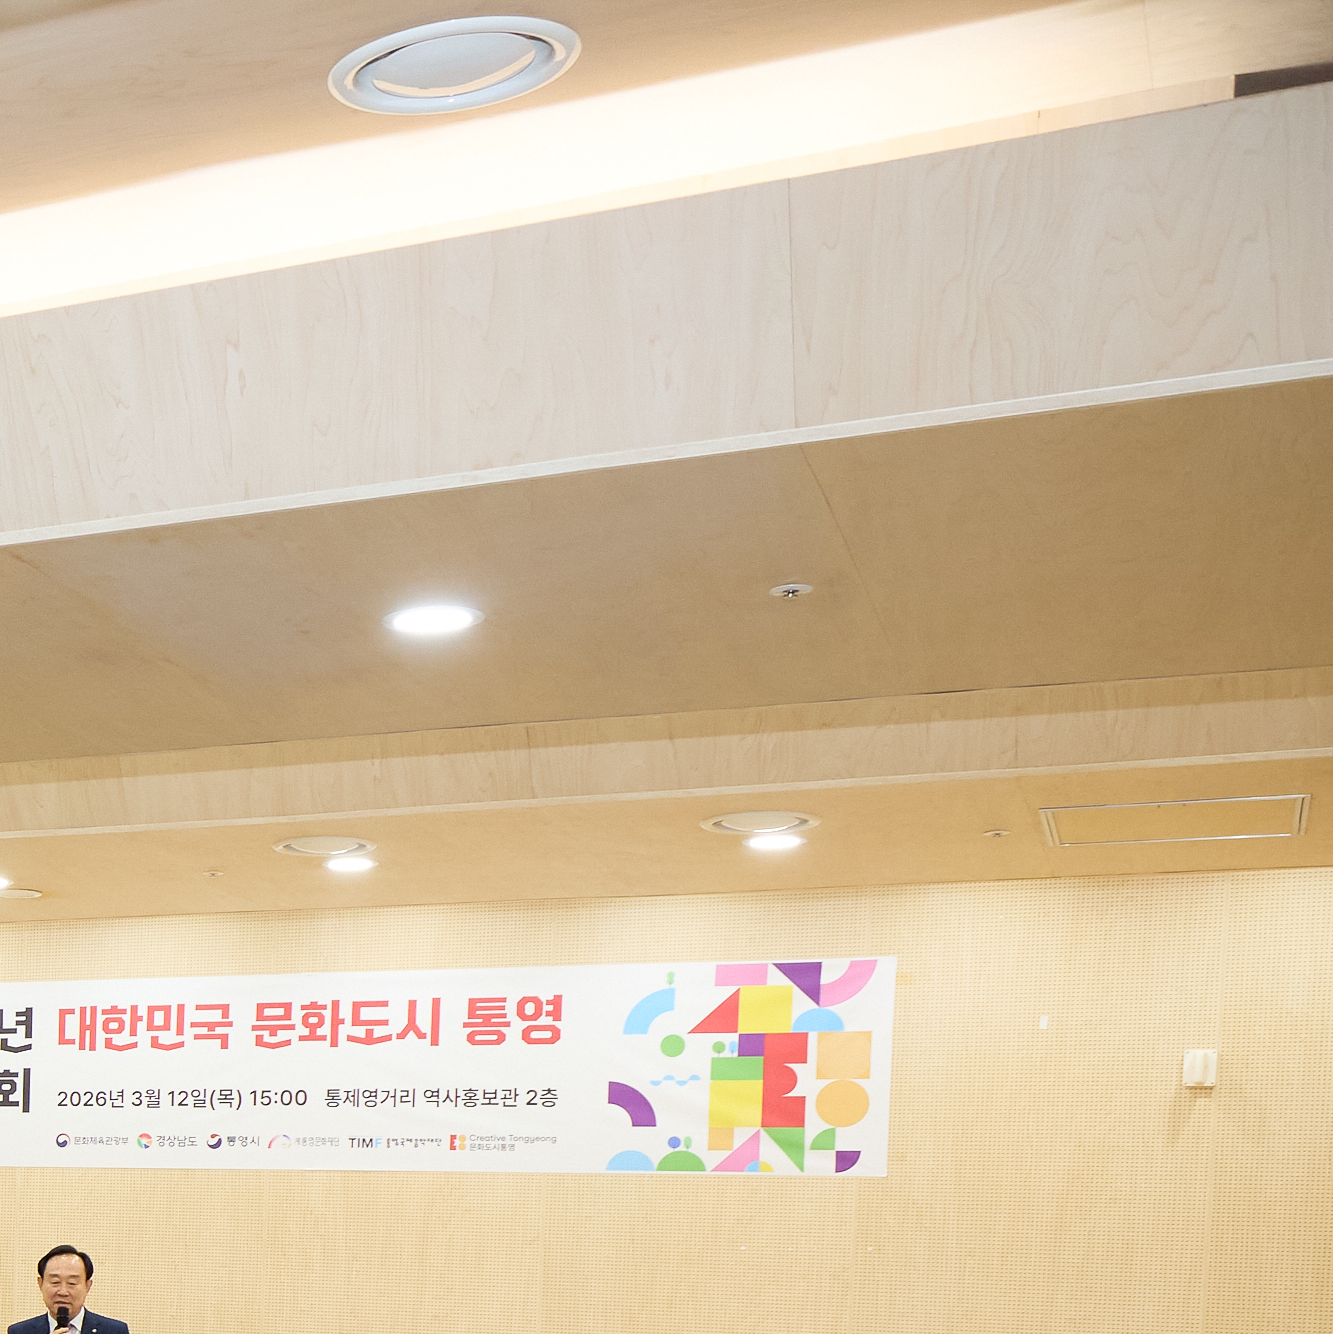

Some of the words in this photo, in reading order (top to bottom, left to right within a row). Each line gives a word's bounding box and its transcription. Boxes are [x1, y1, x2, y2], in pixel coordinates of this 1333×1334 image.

[57, 1003, 234, 1052] 대한민국
[250, 997, 441, 1050] 문화도시
[462, 994, 563, 1046] 통영
[57, 1088, 125, 1109] 2026년
[131, 1088, 161, 1109] 3월
[167, 1088, 243, 1111] 12일(목)
[249, 1089, 308, 1107] 15:00
[324, 1088, 416, 1108] 통제영거리
[423, 1087, 520, 1108] 역사홍보관
[525, 1087, 559, 1108] 2층
[156, 1135, 198, 1148] 경상남도
[226, 1135, 260, 1148] 통영시
[348, 1137, 383, 1149] TIMF
[469, 1134, 506, 1142] Creative
[508, 1134, 557, 1145] Tongyeong
